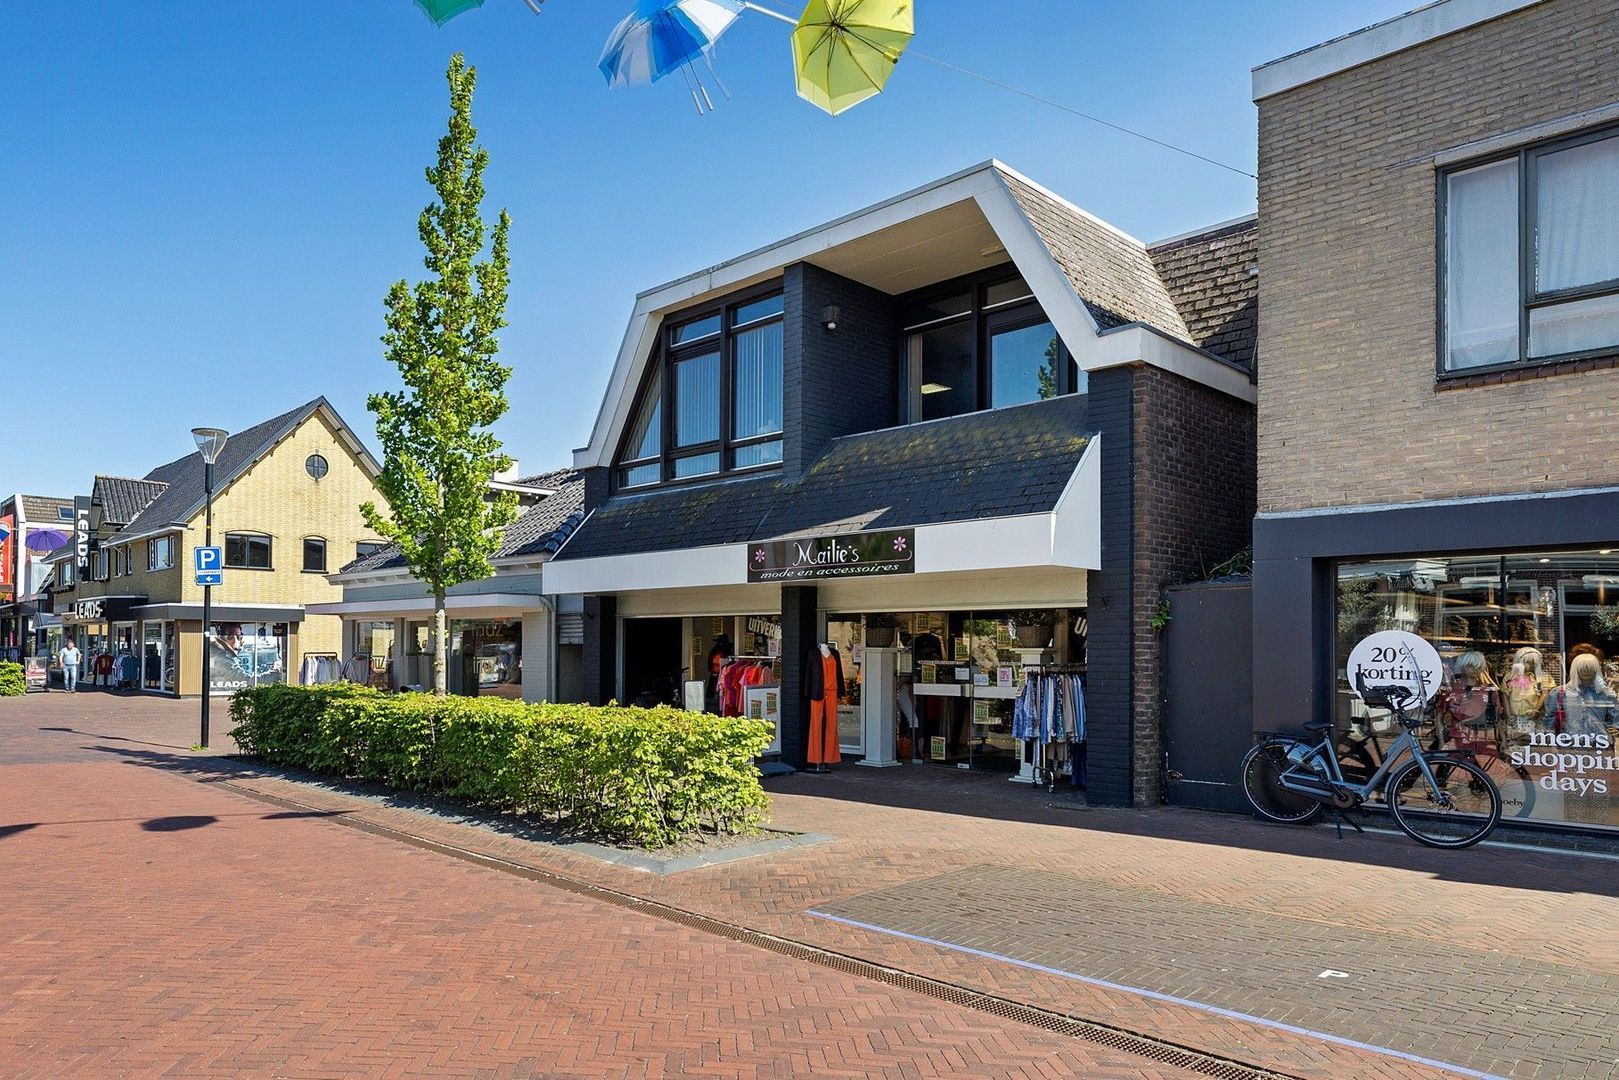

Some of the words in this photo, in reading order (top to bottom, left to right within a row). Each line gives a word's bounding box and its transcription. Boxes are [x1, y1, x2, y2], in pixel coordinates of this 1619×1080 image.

[77, 509, 89, 568] LEADS
[201, 550, 216, 569] P
[793, 539, 860, 566] Mailie's
[760, 567, 794, 579] mode
[797, 569, 813, 577] en
[816, 563, 900, 575] accessoires
[75, 600, 102, 619] LEADS
[1371, 647, 1415, 663] 20%
[1357, 663, 1433, 685] korting
[1529, 732, 1610, 749] men's
[1510, 746, 1619, 774] shoppin
[1540, 770, 1608, 797] days
[1318, 969, 1349, 978] P
